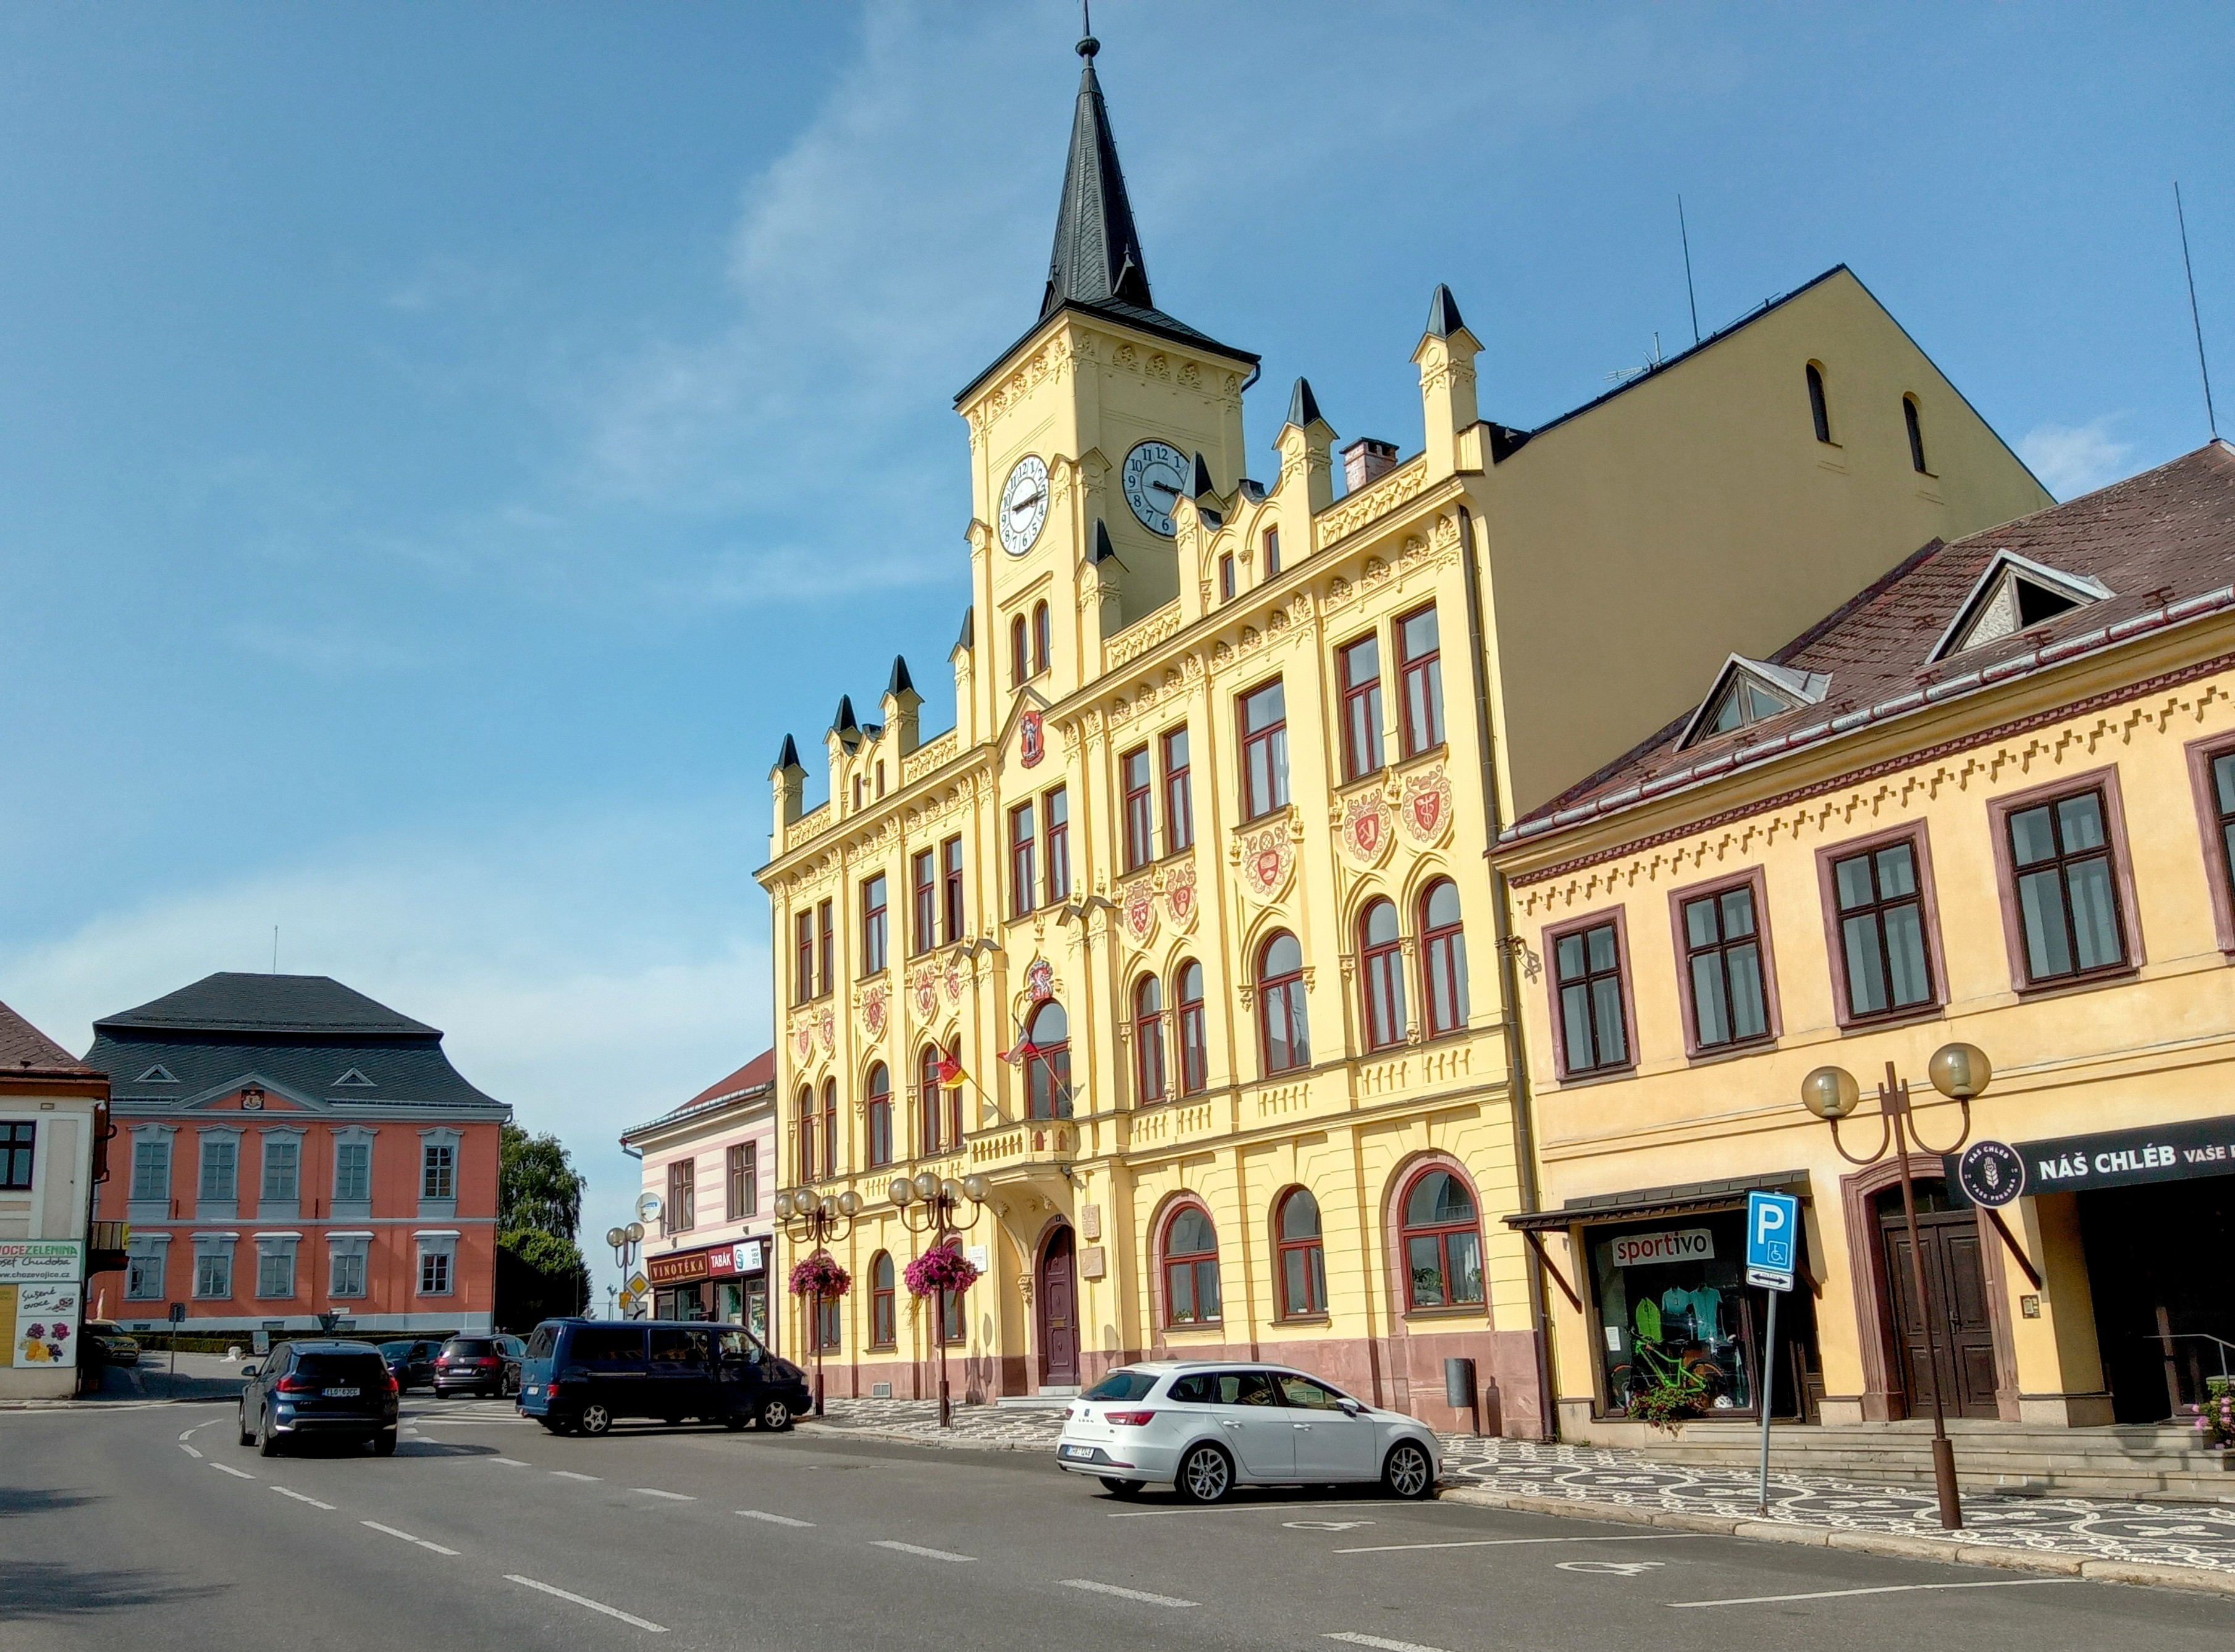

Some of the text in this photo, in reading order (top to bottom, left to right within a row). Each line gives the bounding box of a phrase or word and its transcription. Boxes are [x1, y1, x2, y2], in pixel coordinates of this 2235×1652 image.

[1142, 448, 1152, 461] 11
[1155, 447, 1168, 461] 12
[1030, 460, 1035, 474] 1
[1130, 459, 1143, 472] 10
[1174, 456, 1181, 468] 1
[1018, 462, 1027, 478] 12
[1038, 468, 1043, 482] 2
[1010, 476, 1016, 490] 11
[1128, 475, 1135, 488] 9
[1003, 493, 1011, 509] 10
[1134, 495, 1142, 508] 8
[1038, 503, 1044, 517] 4
[1145, 509, 1153, 522] 7
[1001, 514, 1007, 527] 9
[1161, 518, 1169, 530] 6
[1005, 530, 1010, 542] 8
[1032, 522, 1037, 536] 5
[1012, 535, 1017, 550] 7
[1022, 533, 1028, 547] 6
[2039, 1152, 2089, 1180] NÁŠ
[2094, 1143, 2176, 1174] CHLÉB
[2182, 1144, 2226, 1163] VAŠE
[1757, 1203, 1785, 1245] P
[1617, 1231, 1707, 1265] sportivo
[22, 1256, 71, 1266] Chudoba
[710, 1251, 732, 1268] TABÁK
[653, 1259, 704, 1278] VINOTÉKA
[23, 1299, 50, 1310] ovoce
